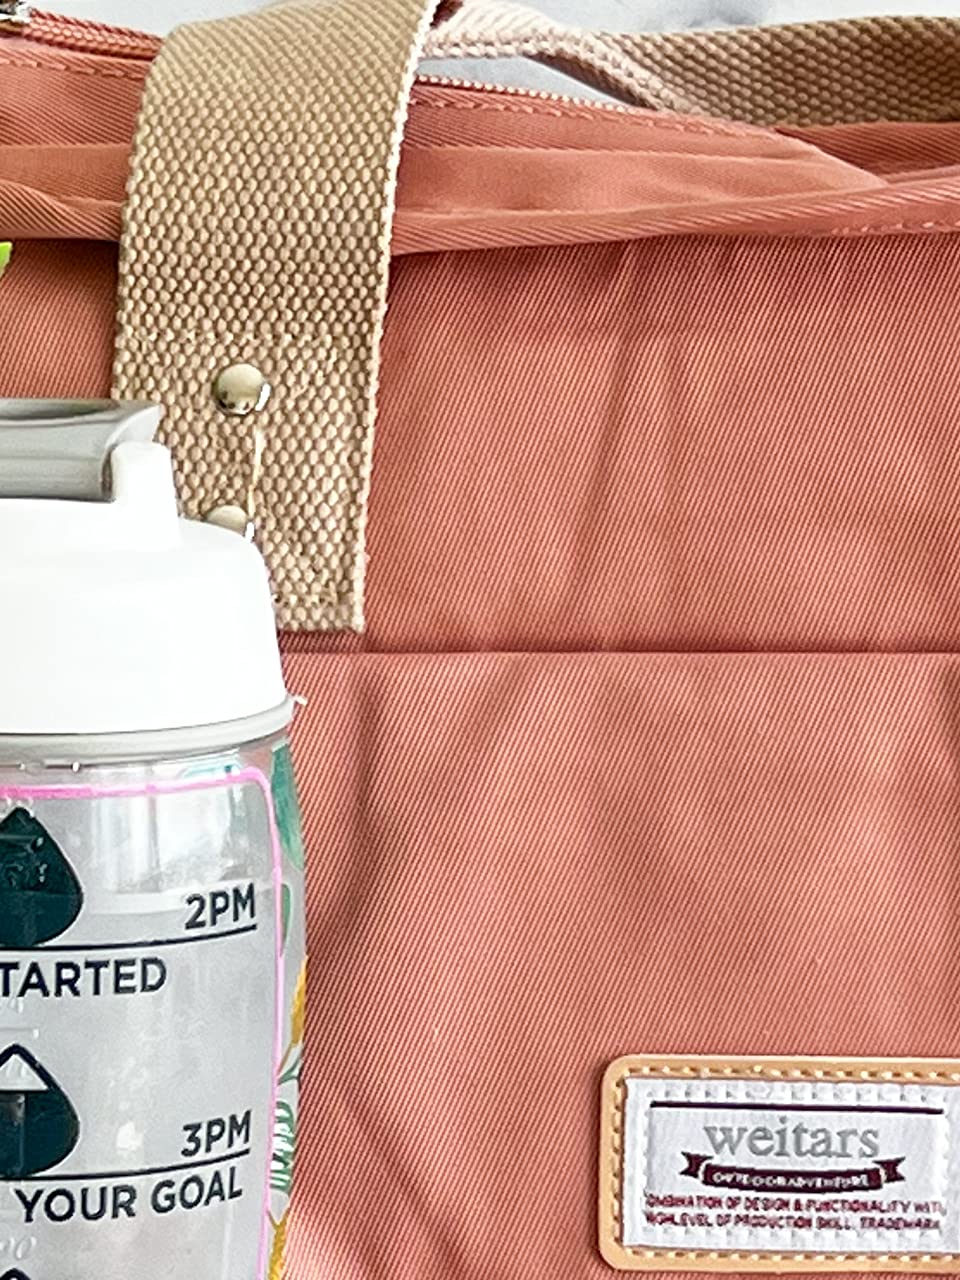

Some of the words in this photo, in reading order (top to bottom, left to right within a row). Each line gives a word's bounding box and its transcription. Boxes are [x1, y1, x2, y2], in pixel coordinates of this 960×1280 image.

[185, 884, 256, 930] 2PM
[181, 1110, 252, 1157] 3PM
[704, 1116, 880, 1158] weitars
[17, 1186, 135, 1223] YOUR
[151, 1168, 242, 1210] GOAL
